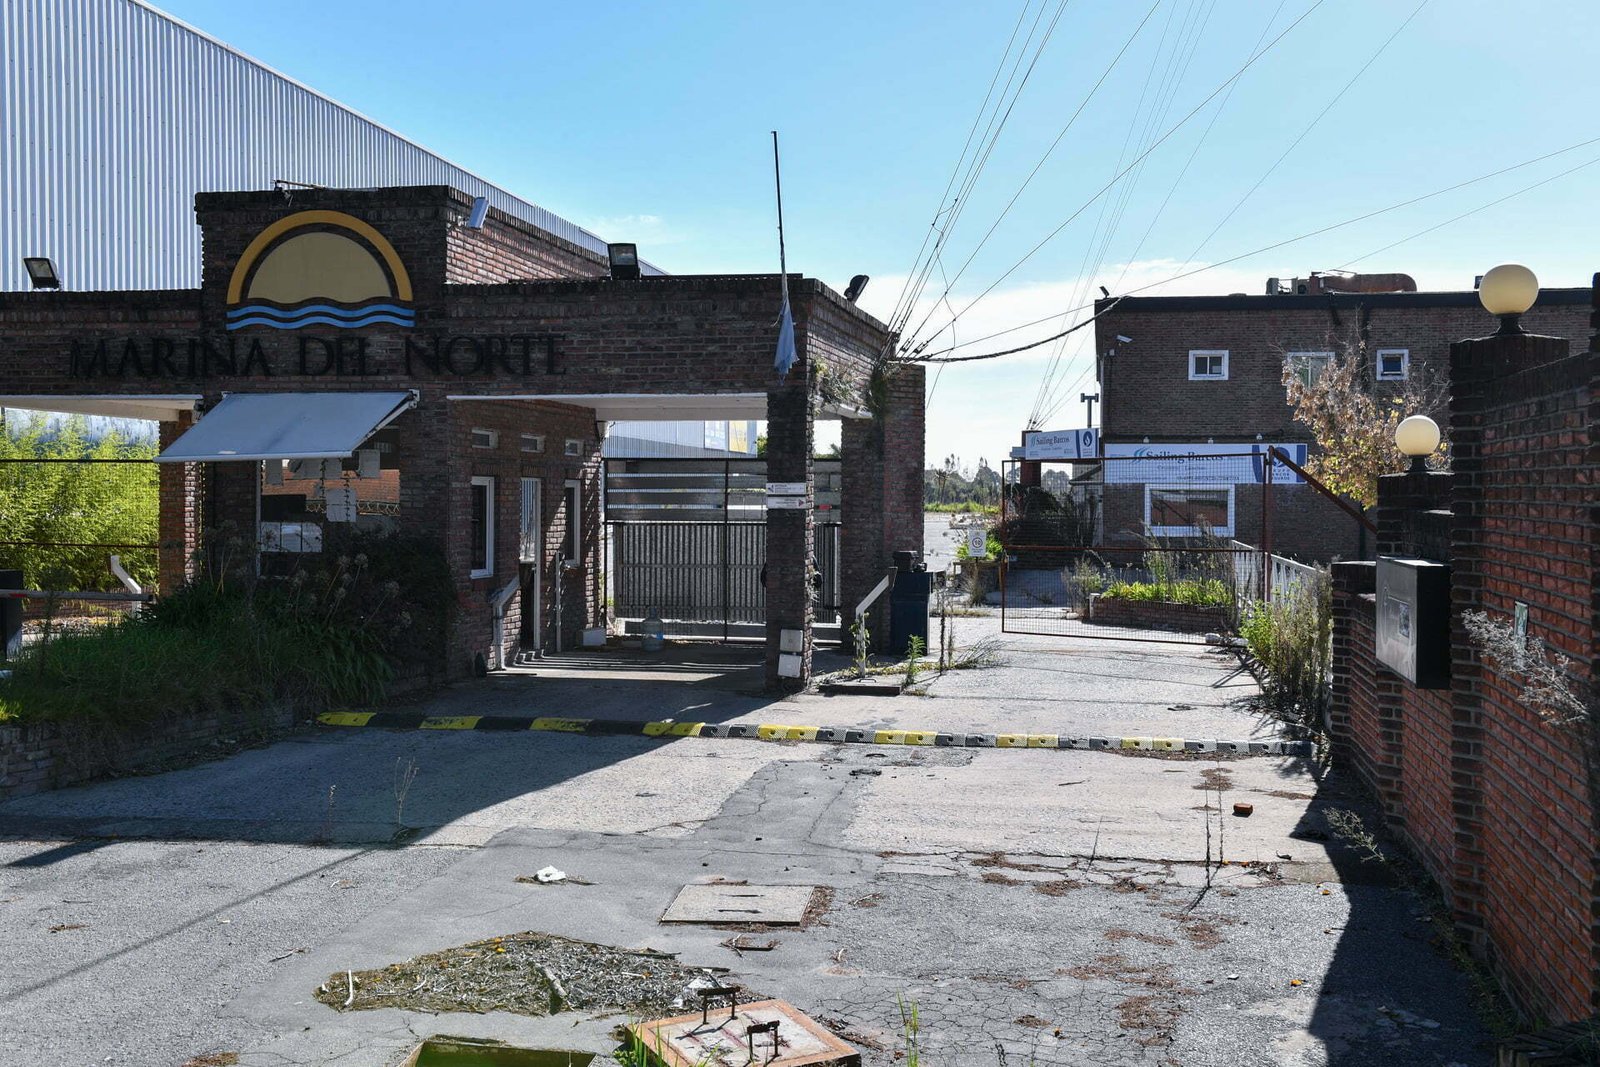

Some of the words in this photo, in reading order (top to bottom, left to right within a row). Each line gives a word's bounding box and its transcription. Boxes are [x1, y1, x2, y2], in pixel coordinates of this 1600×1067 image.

[69, 336, 273, 377] MARINA
[298, 336, 379, 376] DEL
[404, 335, 568, 376] NORTE
[1146, 451, 1185, 464] Sailing
